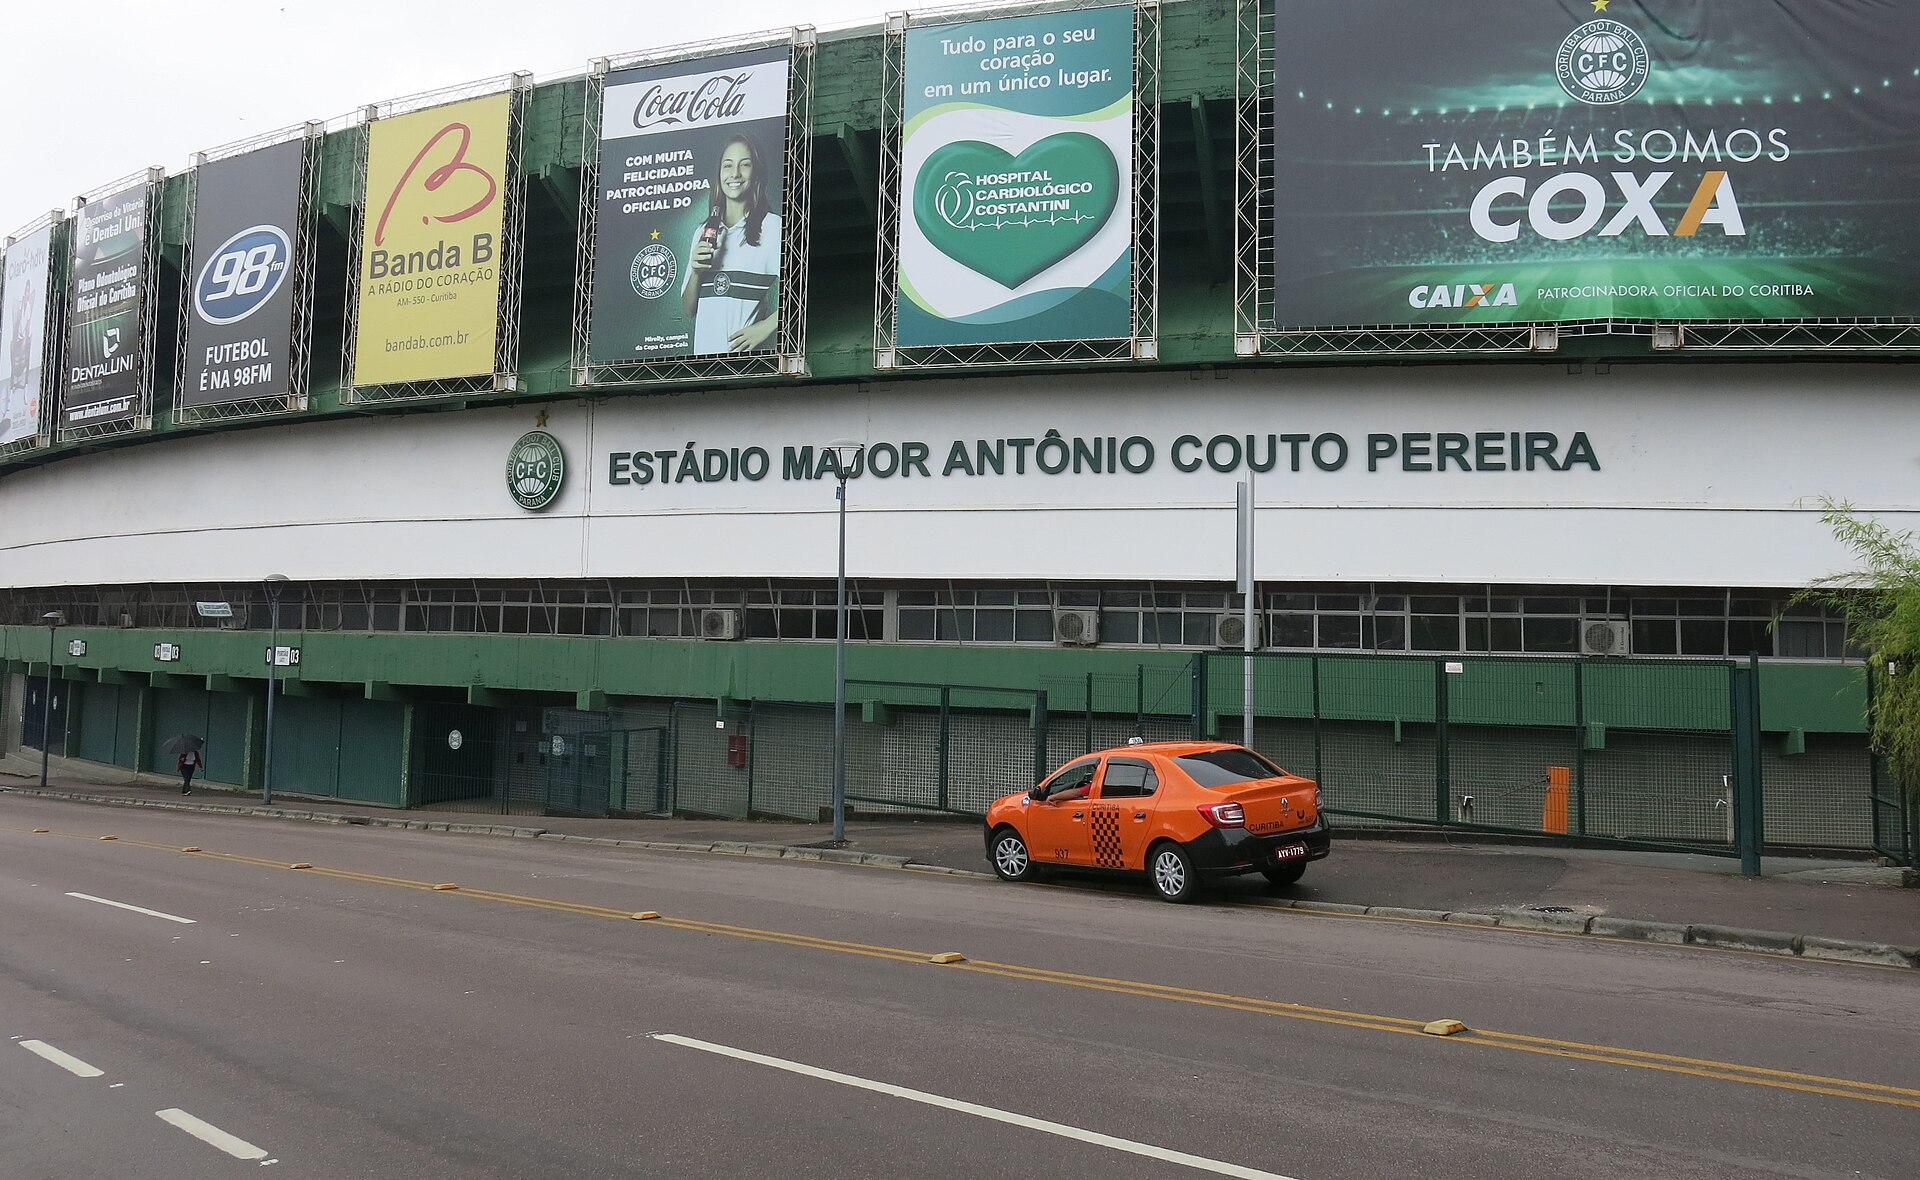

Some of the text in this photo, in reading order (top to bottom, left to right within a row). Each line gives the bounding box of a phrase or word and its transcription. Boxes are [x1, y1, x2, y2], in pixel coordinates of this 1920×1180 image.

[940, 27, 1096, 56] Tudo para o seu
[1558, 22, 1645, 79] CORITIBA FOOT BALL CLUB
[980, 49, 1055, 71] coração
[1578, 52, 1627, 73] CFC
[924, 68, 1112, 98] em um único lugar.
[632, 71, 755, 129] Coca-Cola
[625, 149, 694, 168] COM MUITA
[1422, 128, 1791, 173] TAMBÉM SOMOS
[623, 164, 695, 183] FELICIDADE
[975, 170, 1052, 186] HOSPITAL
[606, 178, 711, 201] PATROCINADORA
[975, 181, 1093, 201] CARDIOLÓGICO
[622, 196, 692, 214] OFICIAL DO
[975, 199, 1070, 216] COSTANTINI
[1469, 170, 1747, 243] COXA
[93, 217, 122, 243] Dental
[124, 212, 143, 232] Uni.
[369, 233, 493, 280] Banda B
[78, 263, 138, 294] Plano Odontológico
[206, 243, 285, 302] 98 fm
[368, 267, 493, 296] A RÁDIO DO CORAÇÃO
[641, 264, 666, 279] CFC
[77, 281, 137, 313] Oficial do Coritiba
[412, 295, 426, 305] 550
[430, 292, 458, 303] Curitiba
[1408, 283, 1519, 309] CAIXA
[1537, 283, 1815, 300] PATROCINADORA OFICIAL DO CORITIBA
[205, 338, 270, 366] FUTEBOL
[385, 330, 470, 352] bandab.com.br
[659, 341, 689, 350] Coca-Cola
[200, 363, 273, 391] É NA 98FM
[541, 437, 556, 455] BALL
[551, 456, 560, 482] CLUB
[609, 428, 1601, 485] ESTÁDIO MAJOR ANTÔNIO COUTO PEREIRA
[516, 461, 547, 479] CFC
[290, 649, 300, 664] 03
[1092, 803, 1120, 811] CURITIBA
[1249, 820, 1285, 832] CURITIBA
[1054, 848, 1069, 859] 937
